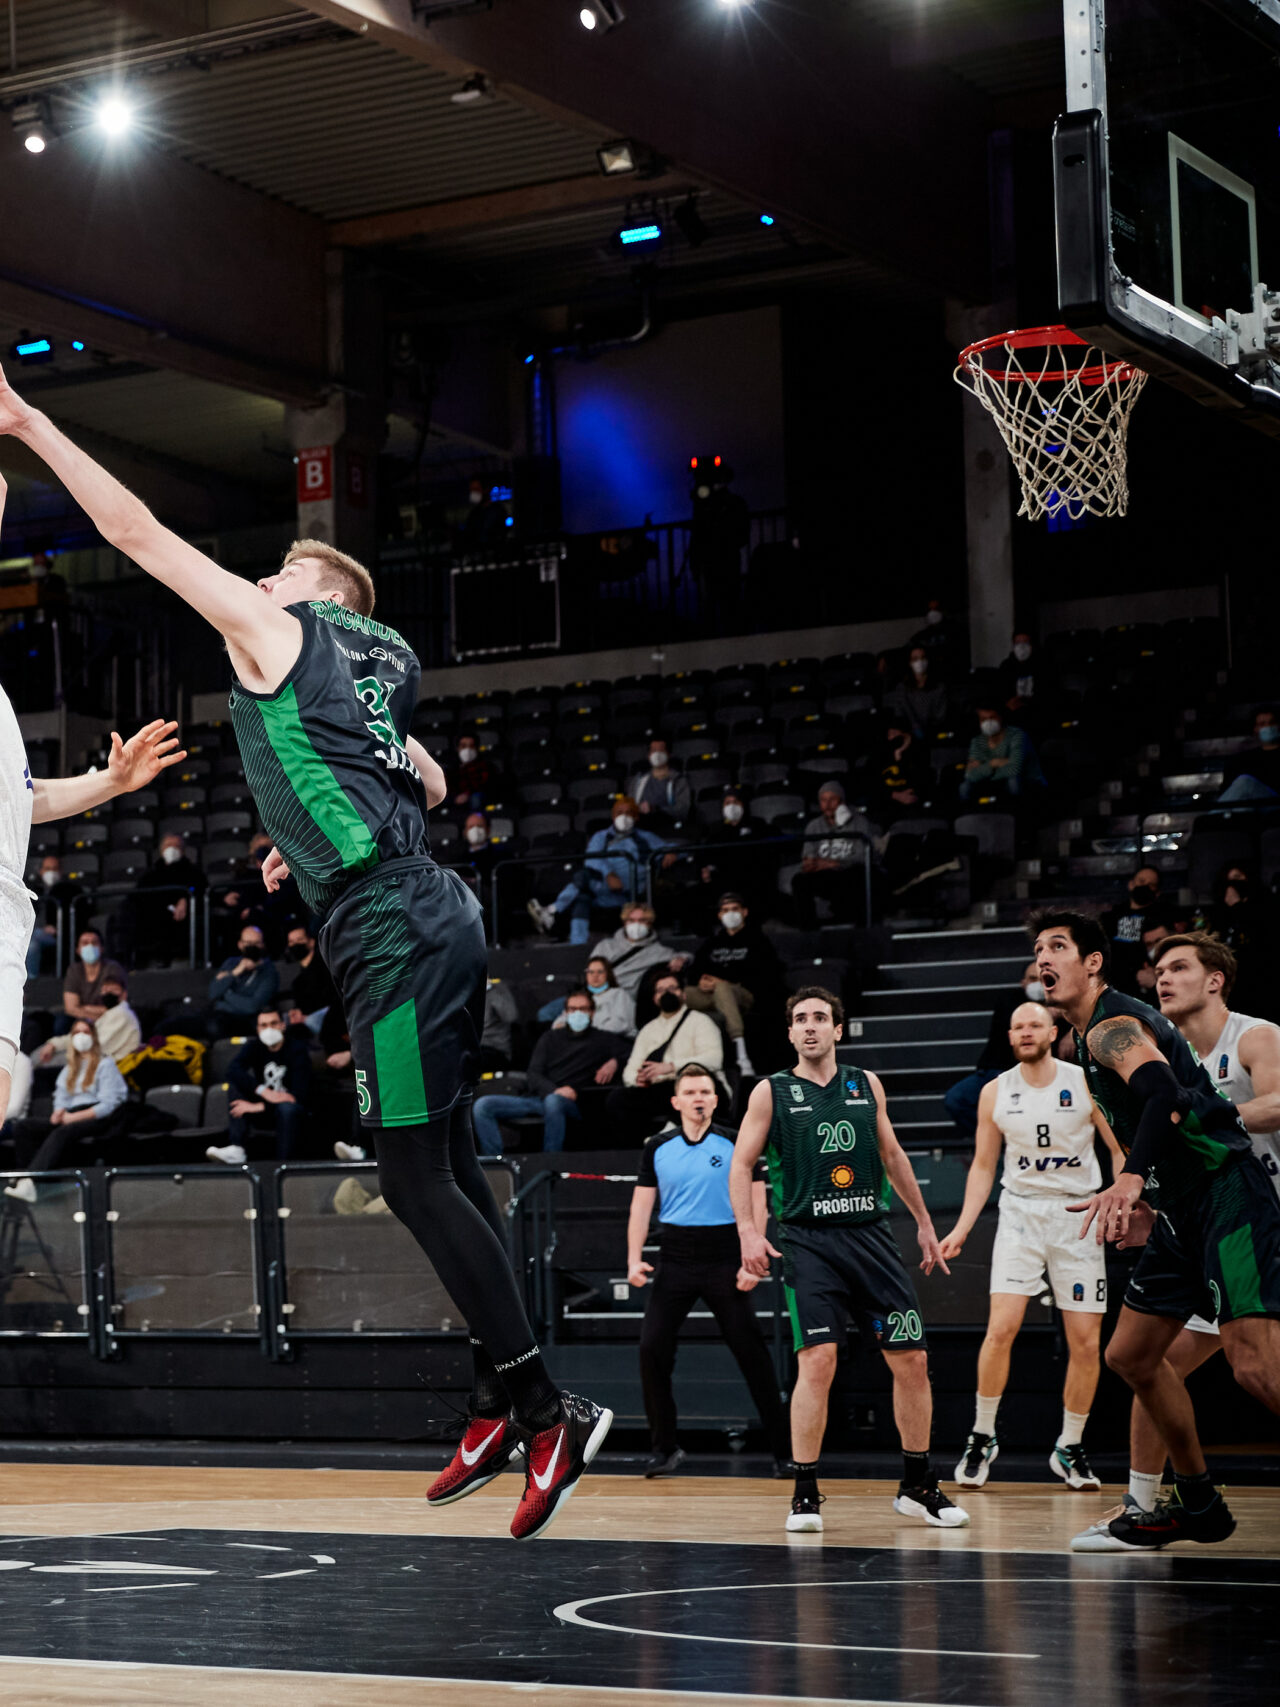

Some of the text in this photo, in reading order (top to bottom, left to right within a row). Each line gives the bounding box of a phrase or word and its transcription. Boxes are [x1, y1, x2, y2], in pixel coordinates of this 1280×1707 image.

[305, 460, 325, 489] B
[387, 652, 406, 674] FUTUR
[817, 1120, 857, 1154] 20
[1037, 1124, 1051, 1148] 8
[812, 1195, 876, 1217] PROBITAS
[887, 1309, 924, 1343] 20
